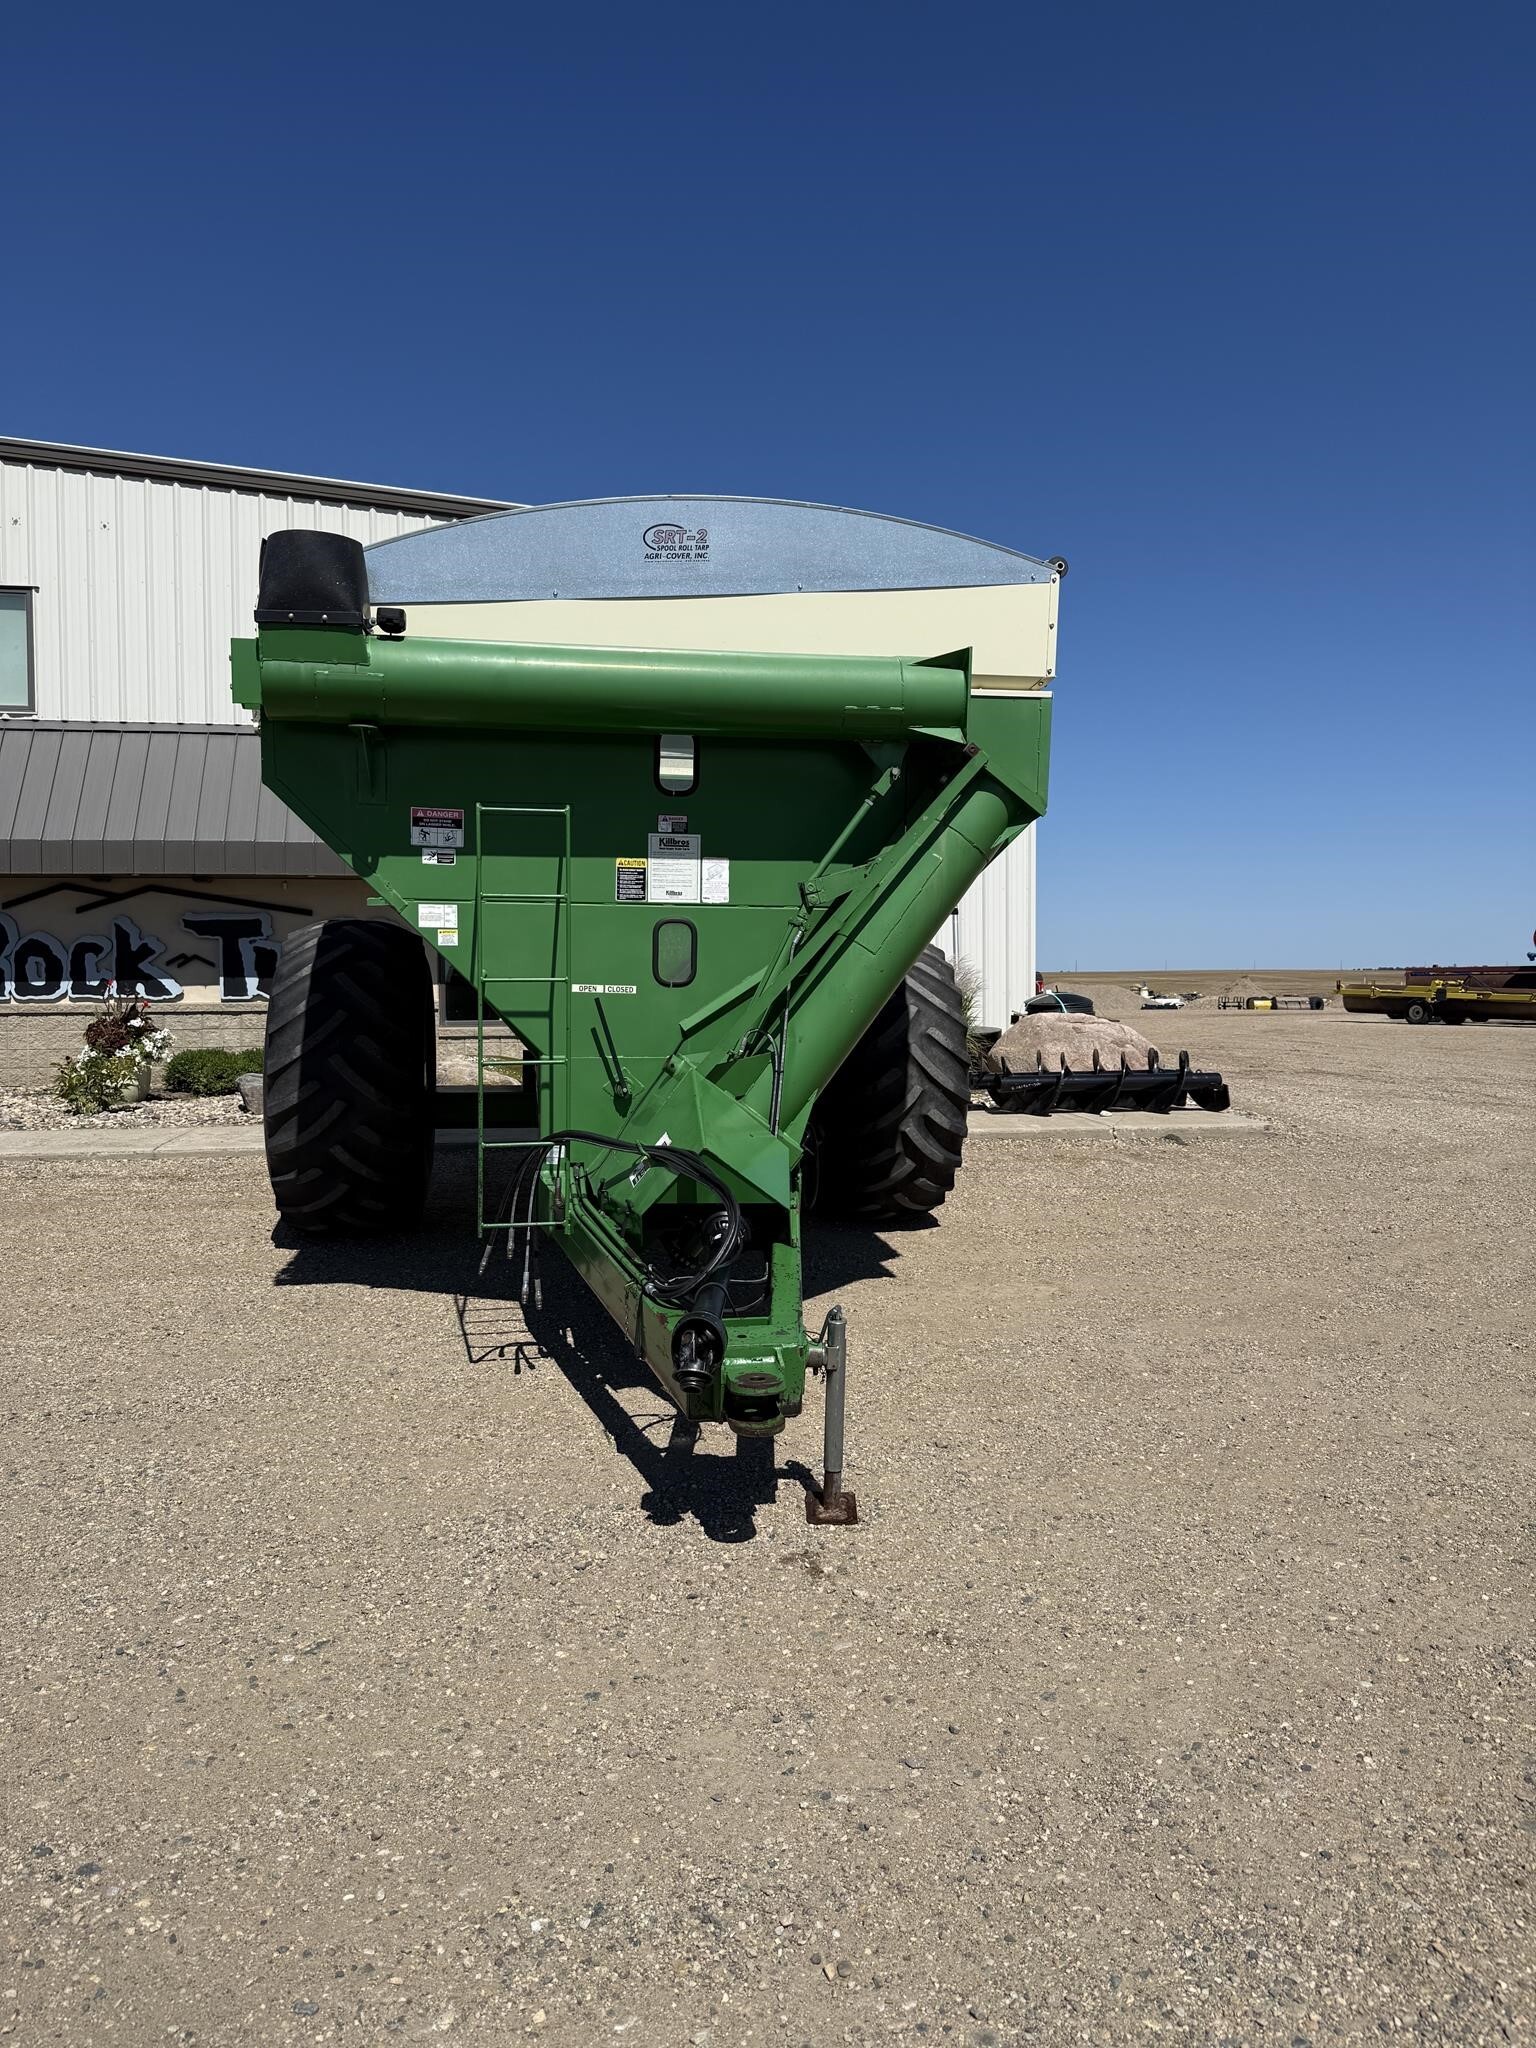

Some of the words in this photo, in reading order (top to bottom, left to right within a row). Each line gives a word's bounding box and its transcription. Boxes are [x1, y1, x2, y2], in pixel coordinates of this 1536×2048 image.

[651, 528, 708, 544] SRT-2
[656, 544, 677, 552] SPOOL
[426, 810, 459, 819] DANGER
[659, 837, 690, 848] Killbros
